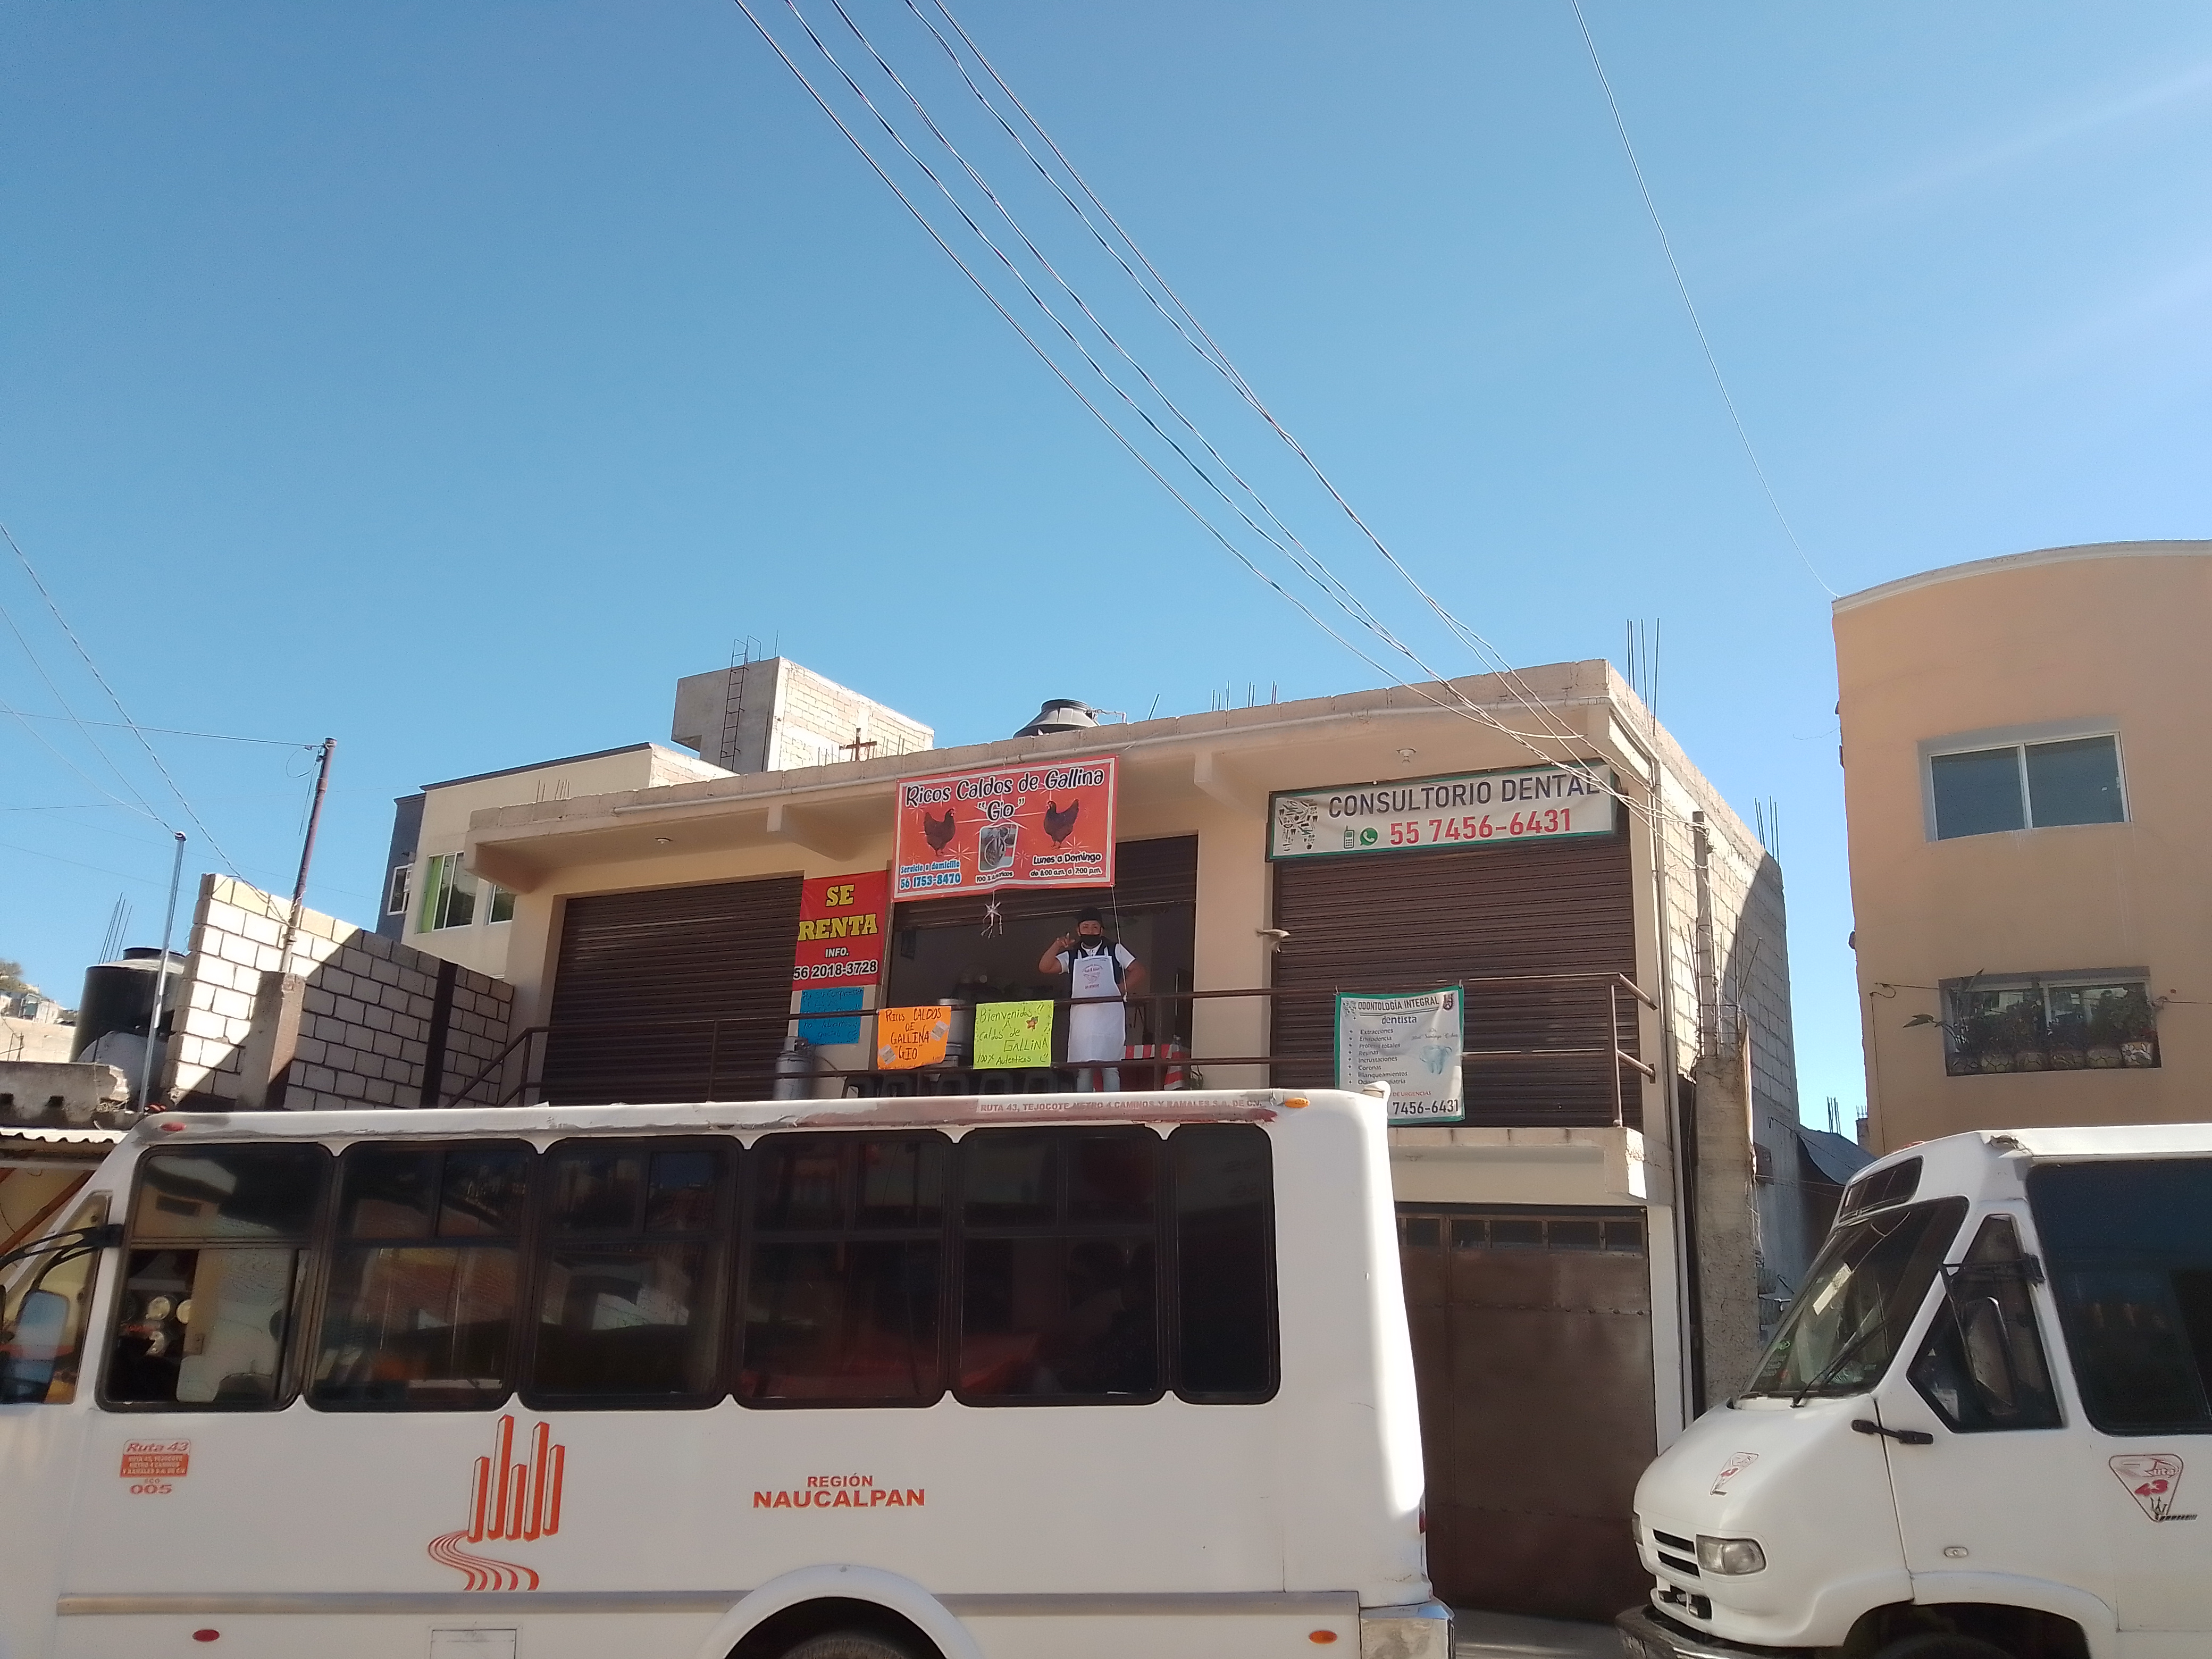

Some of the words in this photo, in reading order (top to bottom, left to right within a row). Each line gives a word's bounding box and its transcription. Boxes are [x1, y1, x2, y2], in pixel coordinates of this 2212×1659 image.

[906, 785, 951, 807] Ricos
[957, 775, 1013, 800] Caldos
[1018, 772, 1039, 793] de
[1045, 768, 1104, 790] Gallina
[1329, 780, 1491, 819] CONSULTORIO
[1501, 770, 1601, 803] DENTAL
[1389, 820, 1420, 846] 55
[1428, 807, 1572, 842] 7456-6431
[1033, 856, 1055, 865] Lunes
[1064, 852, 1101, 863] Domingo
[901, 865, 923, 874] Servicio
[931, 860, 960, 870] domicilio
[900, 878, 910, 889] 56
[912, 873, 961, 887] 1753-8470
[825, 884, 855, 907] SE
[797, 913, 878, 942] RENTA
[825, 947, 850, 958] INFO.
[793, 966, 809, 981] 56
[811, 959, 877, 979] 2018-3728
[1358, 999, 1403, 1011] ODONTOLOGÍA
[1404, 996, 1440, 1009] INTEGRAL
[913, 1007, 942, 1021] CALDOS
[979, 1006, 1033, 1023] Bienvenidos
[1381, 1015, 1418, 1025] dentista
[905, 1021, 915, 1032] DE
[1002, 1020, 1012, 1029] A
[1009, 1027, 1020, 1037] de
[891, 1025, 930, 1045] GALLINA
[1023, 1103, 1069, 1111] TEJOCOTE
[1392, 1099, 1459, 1115] 7456-6431
[127, 1443, 164, 1452] Ruta
[167, 1442, 189, 1452] 43
[807, 1472, 874, 1488] REGIÓN
[130, 1484, 173, 1495] 005
[752, 1488, 925, 1509] NAUCALPAN
